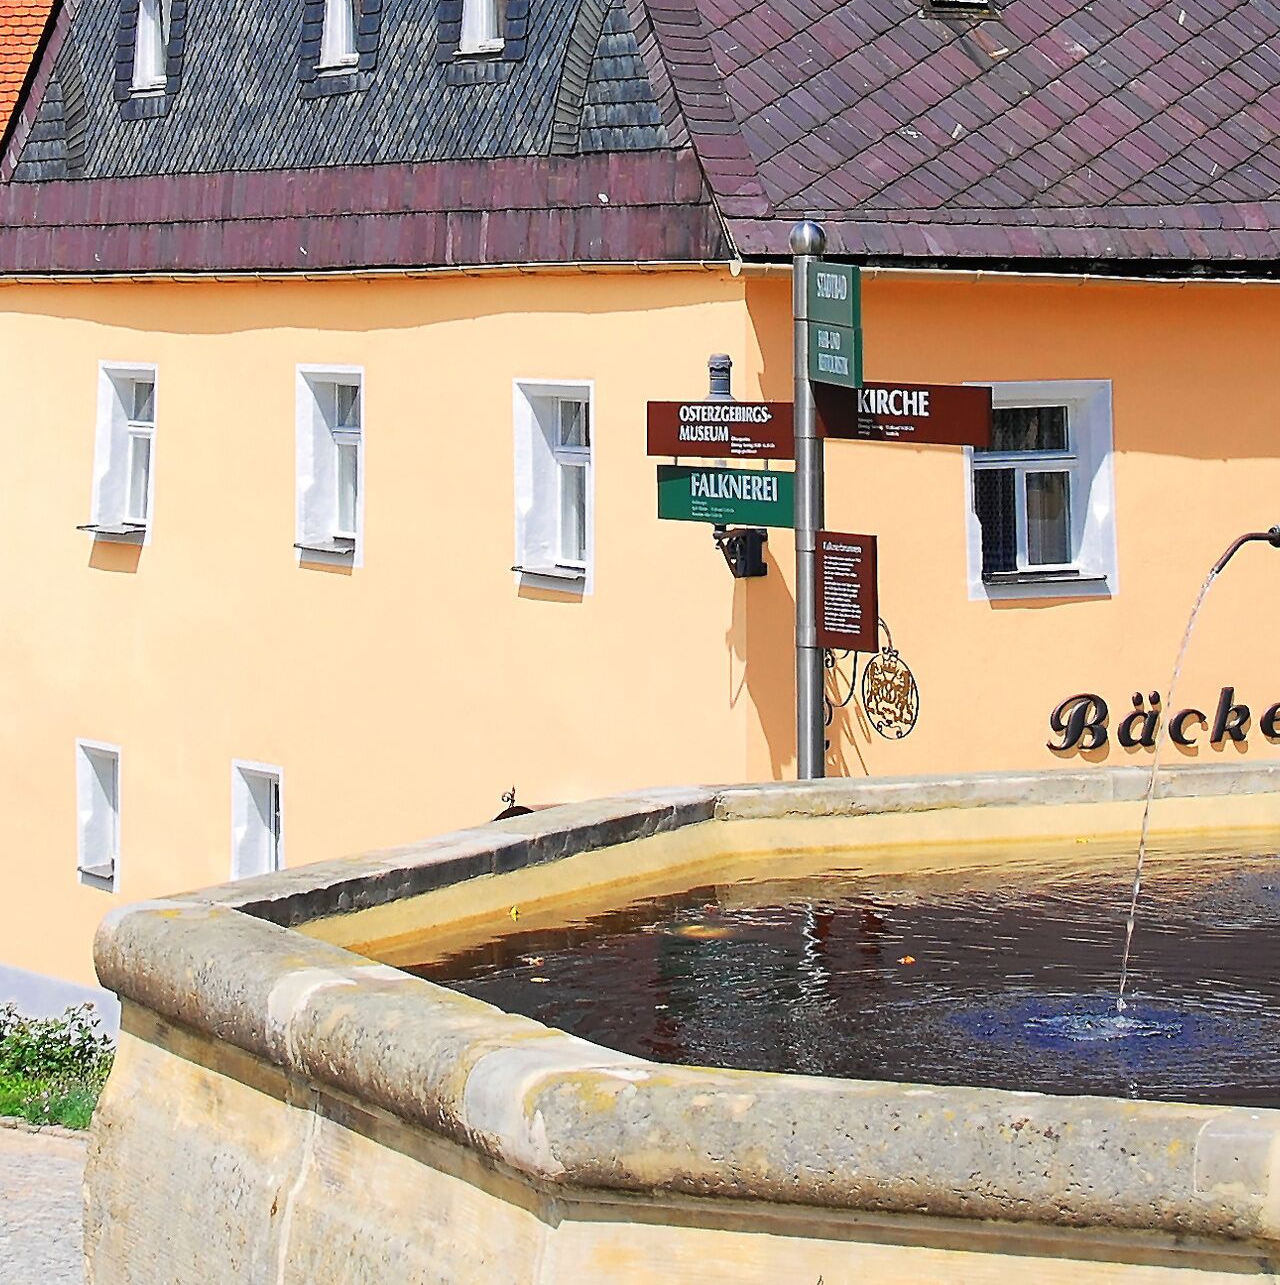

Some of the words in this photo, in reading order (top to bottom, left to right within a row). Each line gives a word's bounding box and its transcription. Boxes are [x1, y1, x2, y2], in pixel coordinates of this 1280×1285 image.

[679, 405, 773, 423] OSTERZGEBIRGS-
[857, 388, 930, 417] KIRCHE
[679, 425, 729, 442] MUSEUM
[691, 472, 778, 502] FALKNEREI
